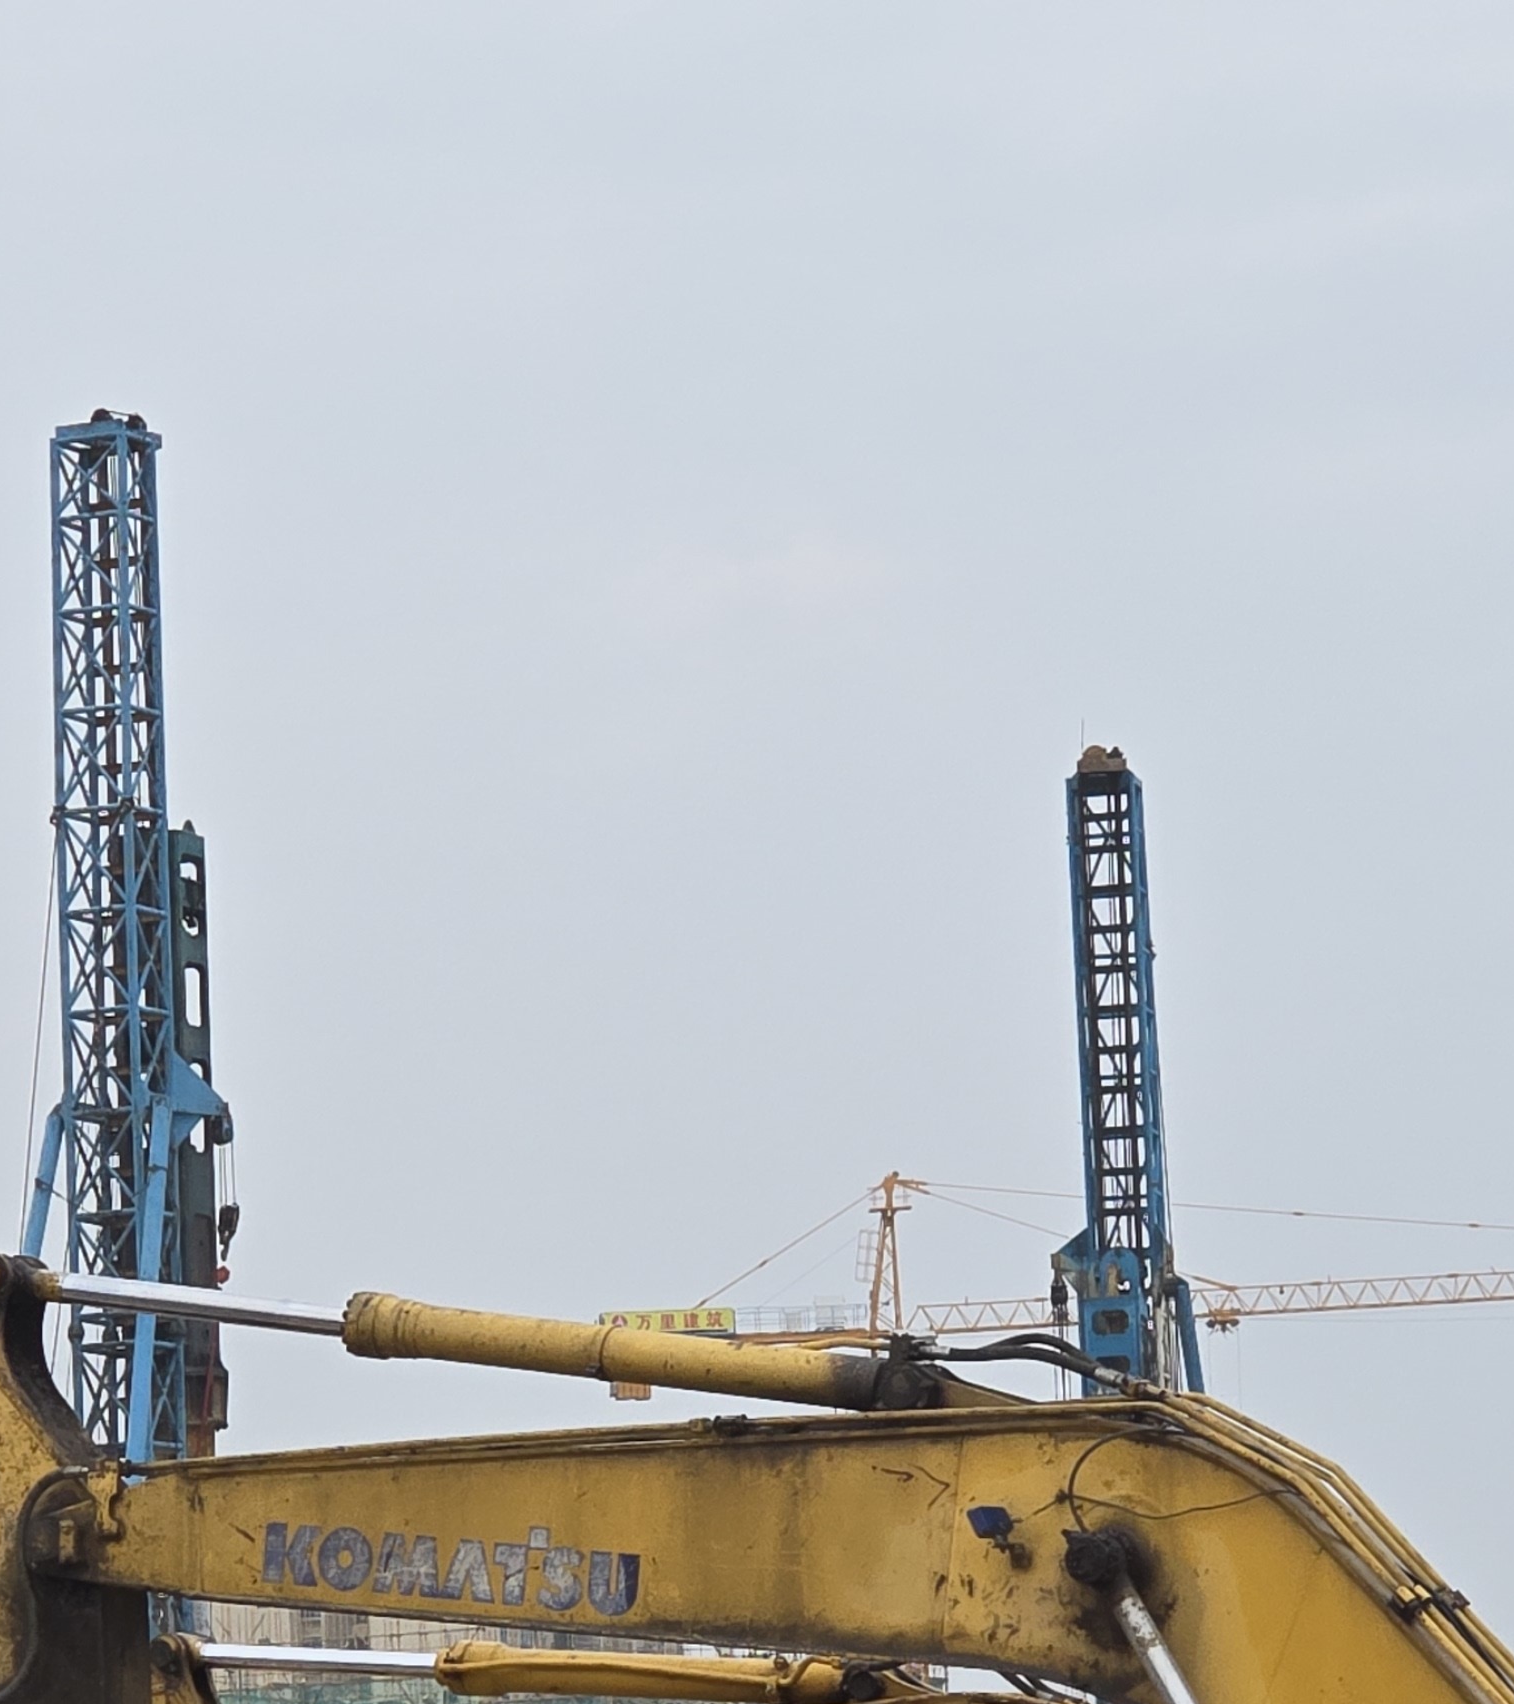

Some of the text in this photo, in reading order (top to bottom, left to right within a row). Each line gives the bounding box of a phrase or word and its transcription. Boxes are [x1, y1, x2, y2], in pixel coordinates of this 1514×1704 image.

[636, 1311, 724, 1330] 万里建筑
[262, 1522, 640, 1616] KOMATSU
